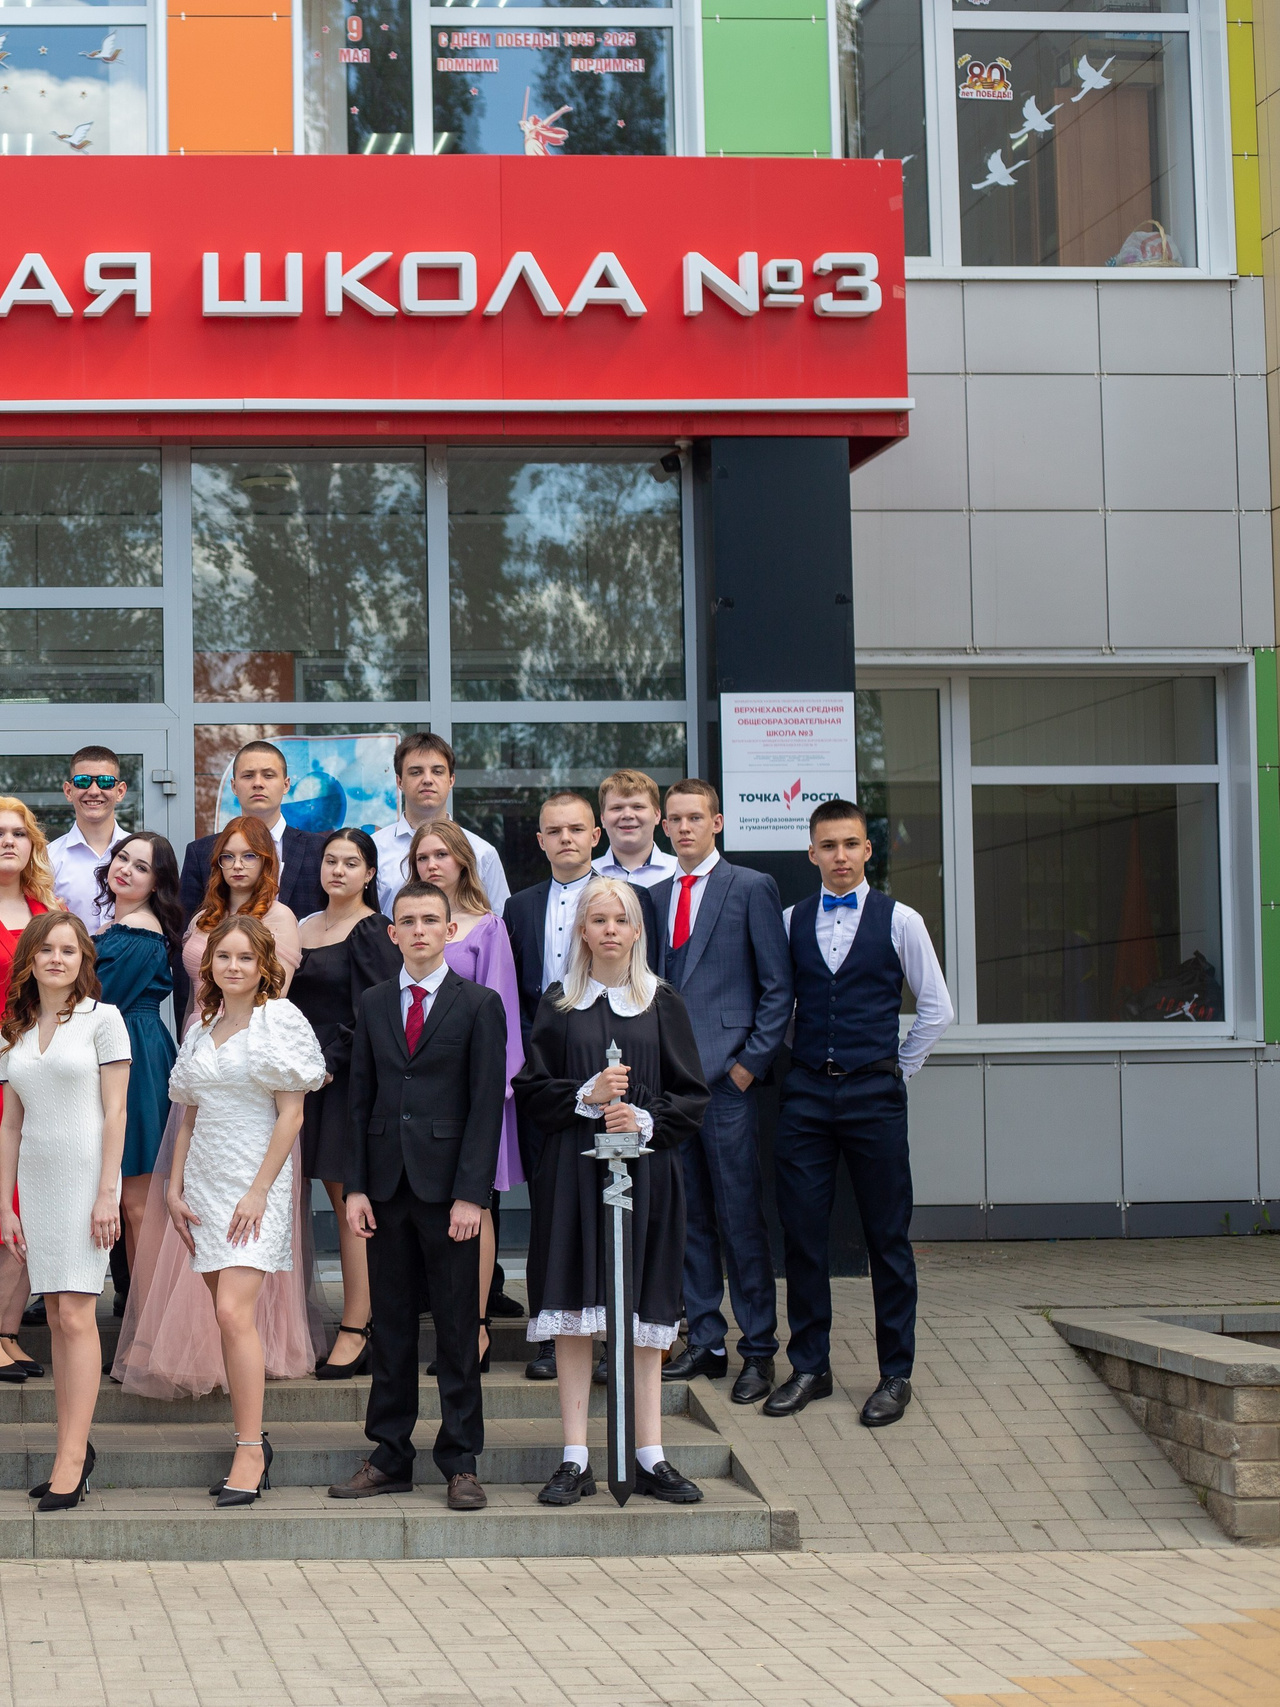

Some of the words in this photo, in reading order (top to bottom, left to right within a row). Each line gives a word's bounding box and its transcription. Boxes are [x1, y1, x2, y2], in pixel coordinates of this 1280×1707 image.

[347, 16, 363, 42] 9
[438, 32, 449, 47] С
[495, 32, 560, 50] ПОБЕДЫ!
[338, 48, 371, 63] МАЯ
[437, 58, 499, 72] ПОМНИМ!
[571, 58, 645, 74] ГОРДИМСЯ!
[968, 62, 1005, 90] 80
[976, 90, 1012, 99] ПОБЕДЫ!
[202, 251, 648, 317] ШКОЛА
[683, 251, 883, 317] №3
[734, 706, 804, 714] ВЕРХНЕХАВСКАЯ
[738, 718, 841, 726] ОБЩЕОБРАЗОВАТЕЛЬНАЯ
[739, 793, 781, 802] ТОЧКА
[801, 793, 840, 802] РОСТА
[740, 817, 759, 825] Центр
[761, 817, 804, 825] образования
